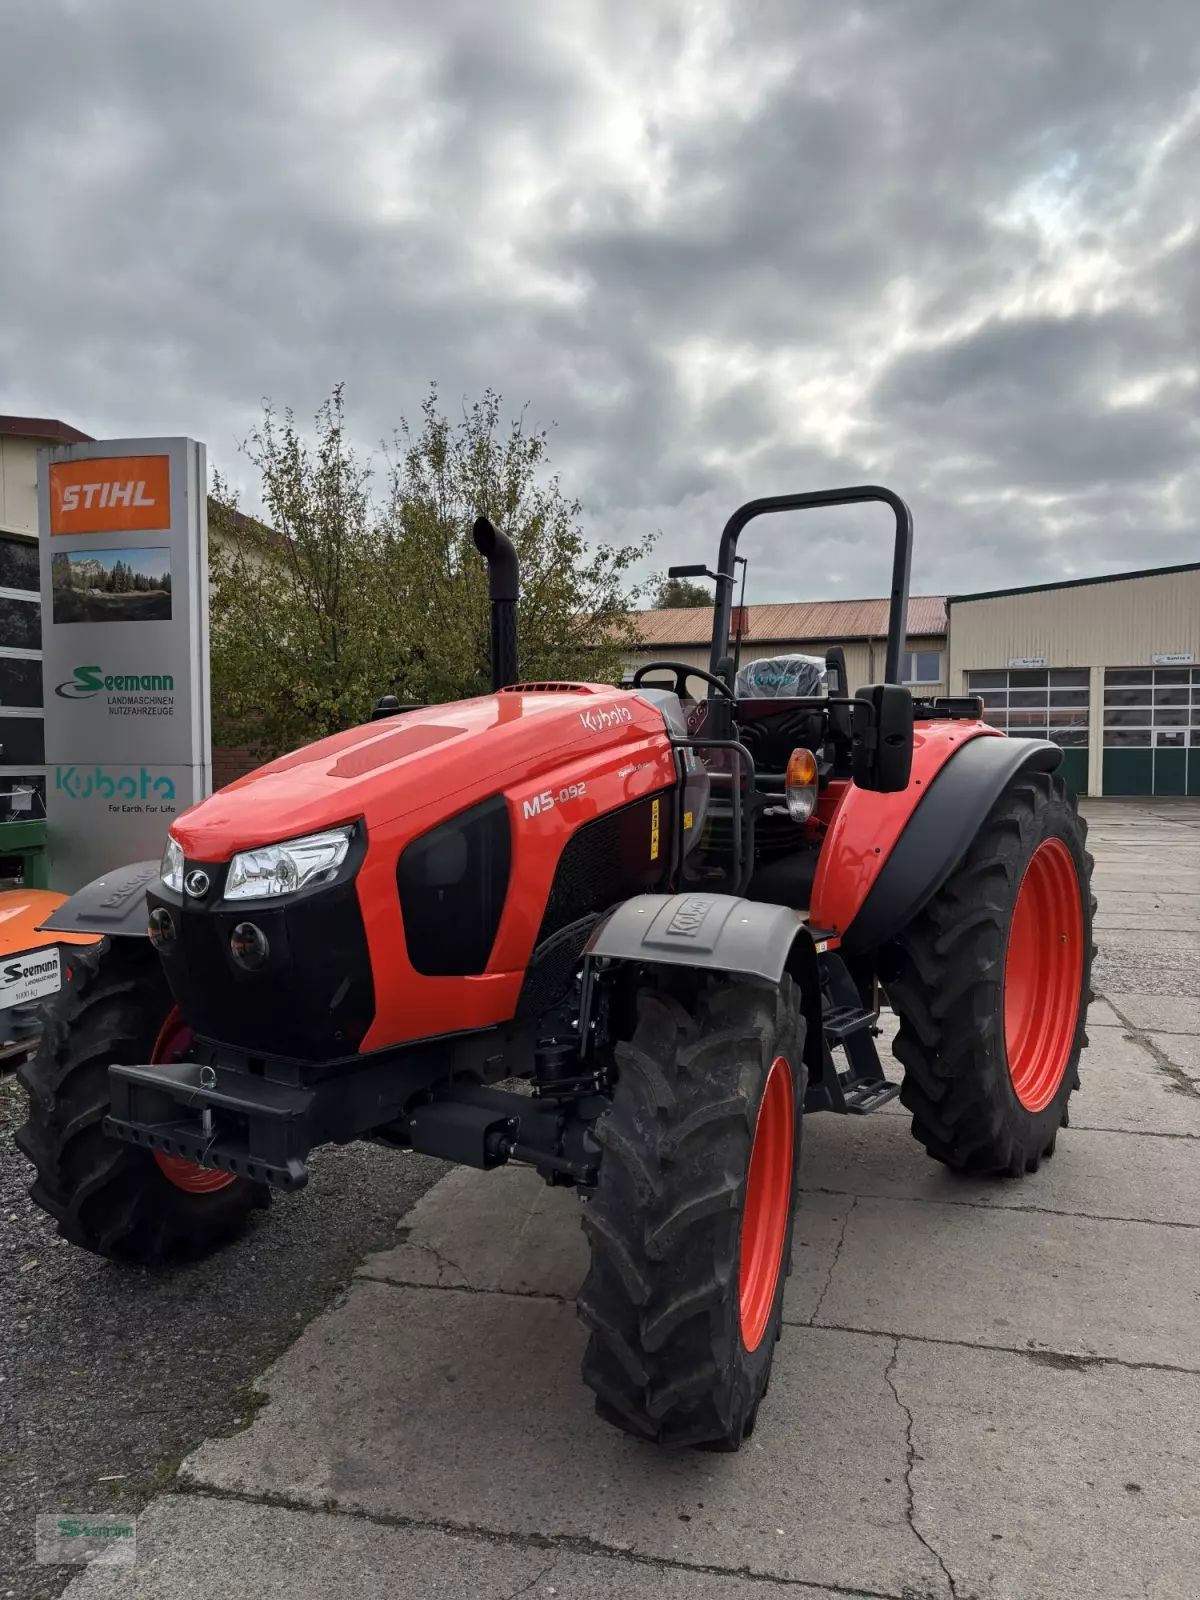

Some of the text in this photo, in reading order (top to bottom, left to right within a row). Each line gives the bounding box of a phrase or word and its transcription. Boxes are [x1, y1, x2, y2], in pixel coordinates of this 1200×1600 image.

[61, 481, 156, 512] STIHL
[73, 666, 174, 692] Seemann
[107, 696, 174, 705] LANDMASCHINEN
[109, 706, 174, 715] NUTZFAHRZEUGE
[580, 704, 632, 731] Kubota
[56, 766, 176, 799] Kubota
[108, 804, 120, 812] For
[145, 804, 158, 812] For
[523, 782, 586, 819] M5-092
[4, 960, 58, 983] Seemann
